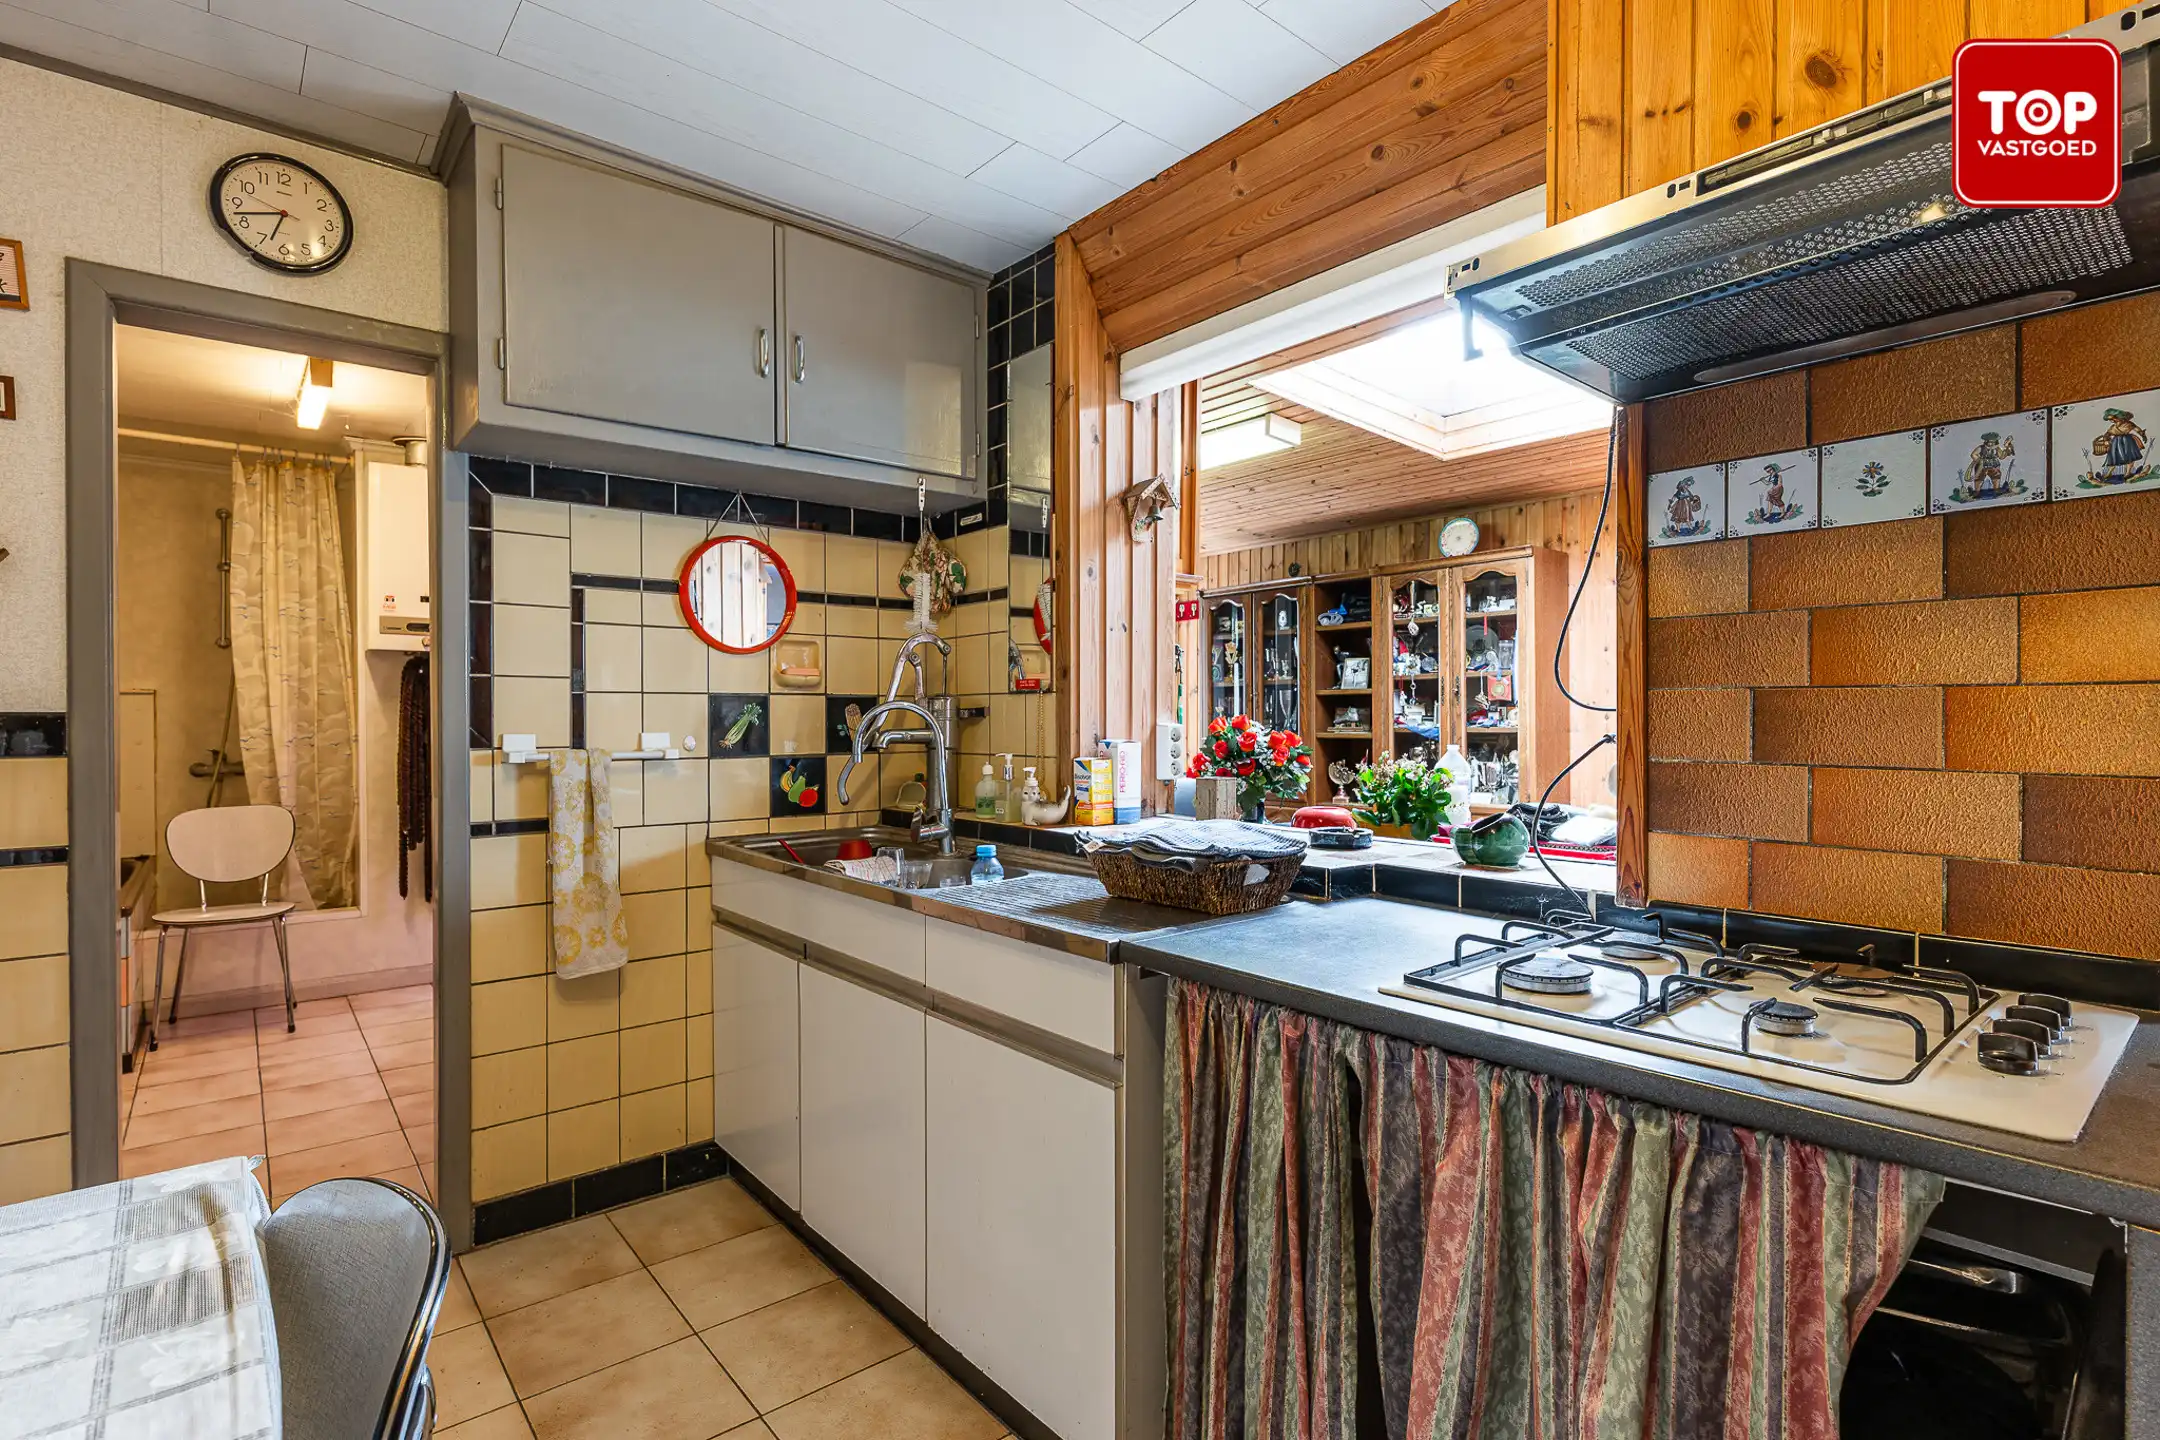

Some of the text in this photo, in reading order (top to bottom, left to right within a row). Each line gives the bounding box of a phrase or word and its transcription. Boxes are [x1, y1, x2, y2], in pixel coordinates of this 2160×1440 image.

[257, 171, 269, 185] 11
[276, 171, 291, 187] 12
[240, 180, 255, 195] 10
[304, 182, 308, 194] 1
[231, 196, 243, 209] 9
[316, 199, 327, 212] 2
[239, 216, 250, 229] 8
[324, 219, 334, 232] 3
[256, 231, 268, 244] 7
[317, 235, 326, 247] 4
[278, 243, 290, 255] 6
[301, 243, 311, 256] 5
